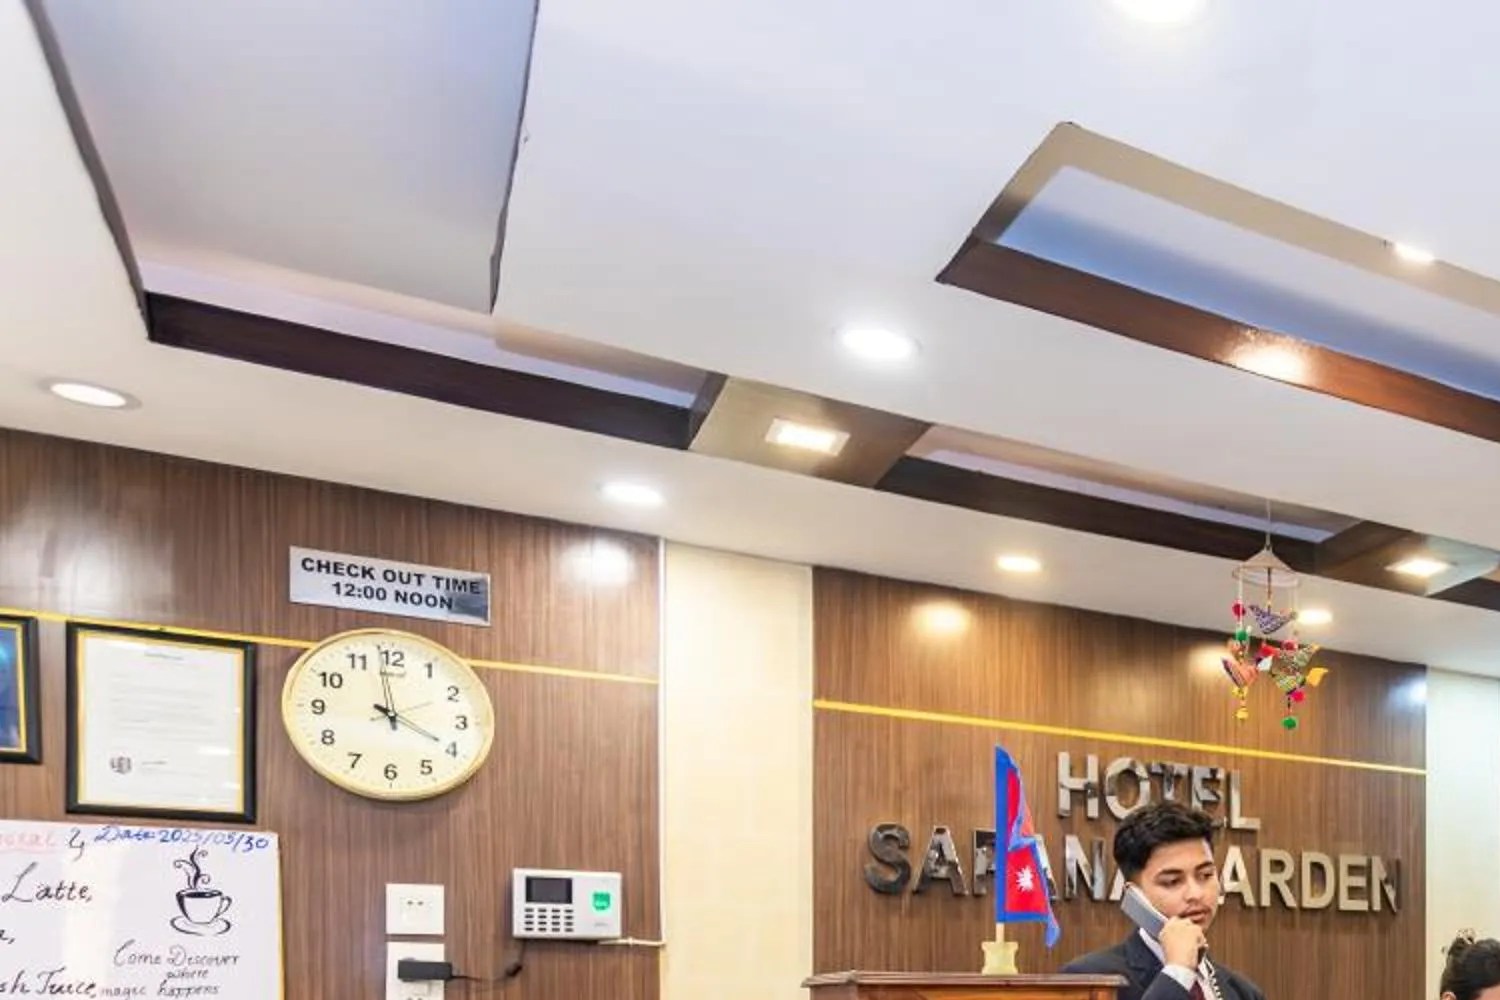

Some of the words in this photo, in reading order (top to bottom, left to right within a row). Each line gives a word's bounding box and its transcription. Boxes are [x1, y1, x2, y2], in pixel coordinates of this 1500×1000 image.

[301, 557, 375, 580] CHECK
[383, 569, 426, 587] OUT
[432, 575, 481, 595] TIME
[332, 581, 387, 601] 12:00
[395, 590, 453, 611] NOON
[347, 653, 367, 671] 11
[381, 649, 405, 668] 12
[424, 662, 433, 679] 1
[319, 671, 344, 689] 10
[447, 685, 460, 703] 2
[311, 699, 326, 715] 9
[455, 715, 468, 731] 3
[321, 729, 335, 745] 8
[445, 741, 458, 759] 4
[348, 752, 363, 769] 7
[420, 759, 433, 776] 5
[383, 763, 398, 781] 6
[1058, 751, 1261, 830] HOTEL
[2, 861, 93, 903] Latte,
[1217, 845, 1401, 913] ARDEN
[113, 939, 162, 967] Come
[157, 979, 220, 1000] happens
